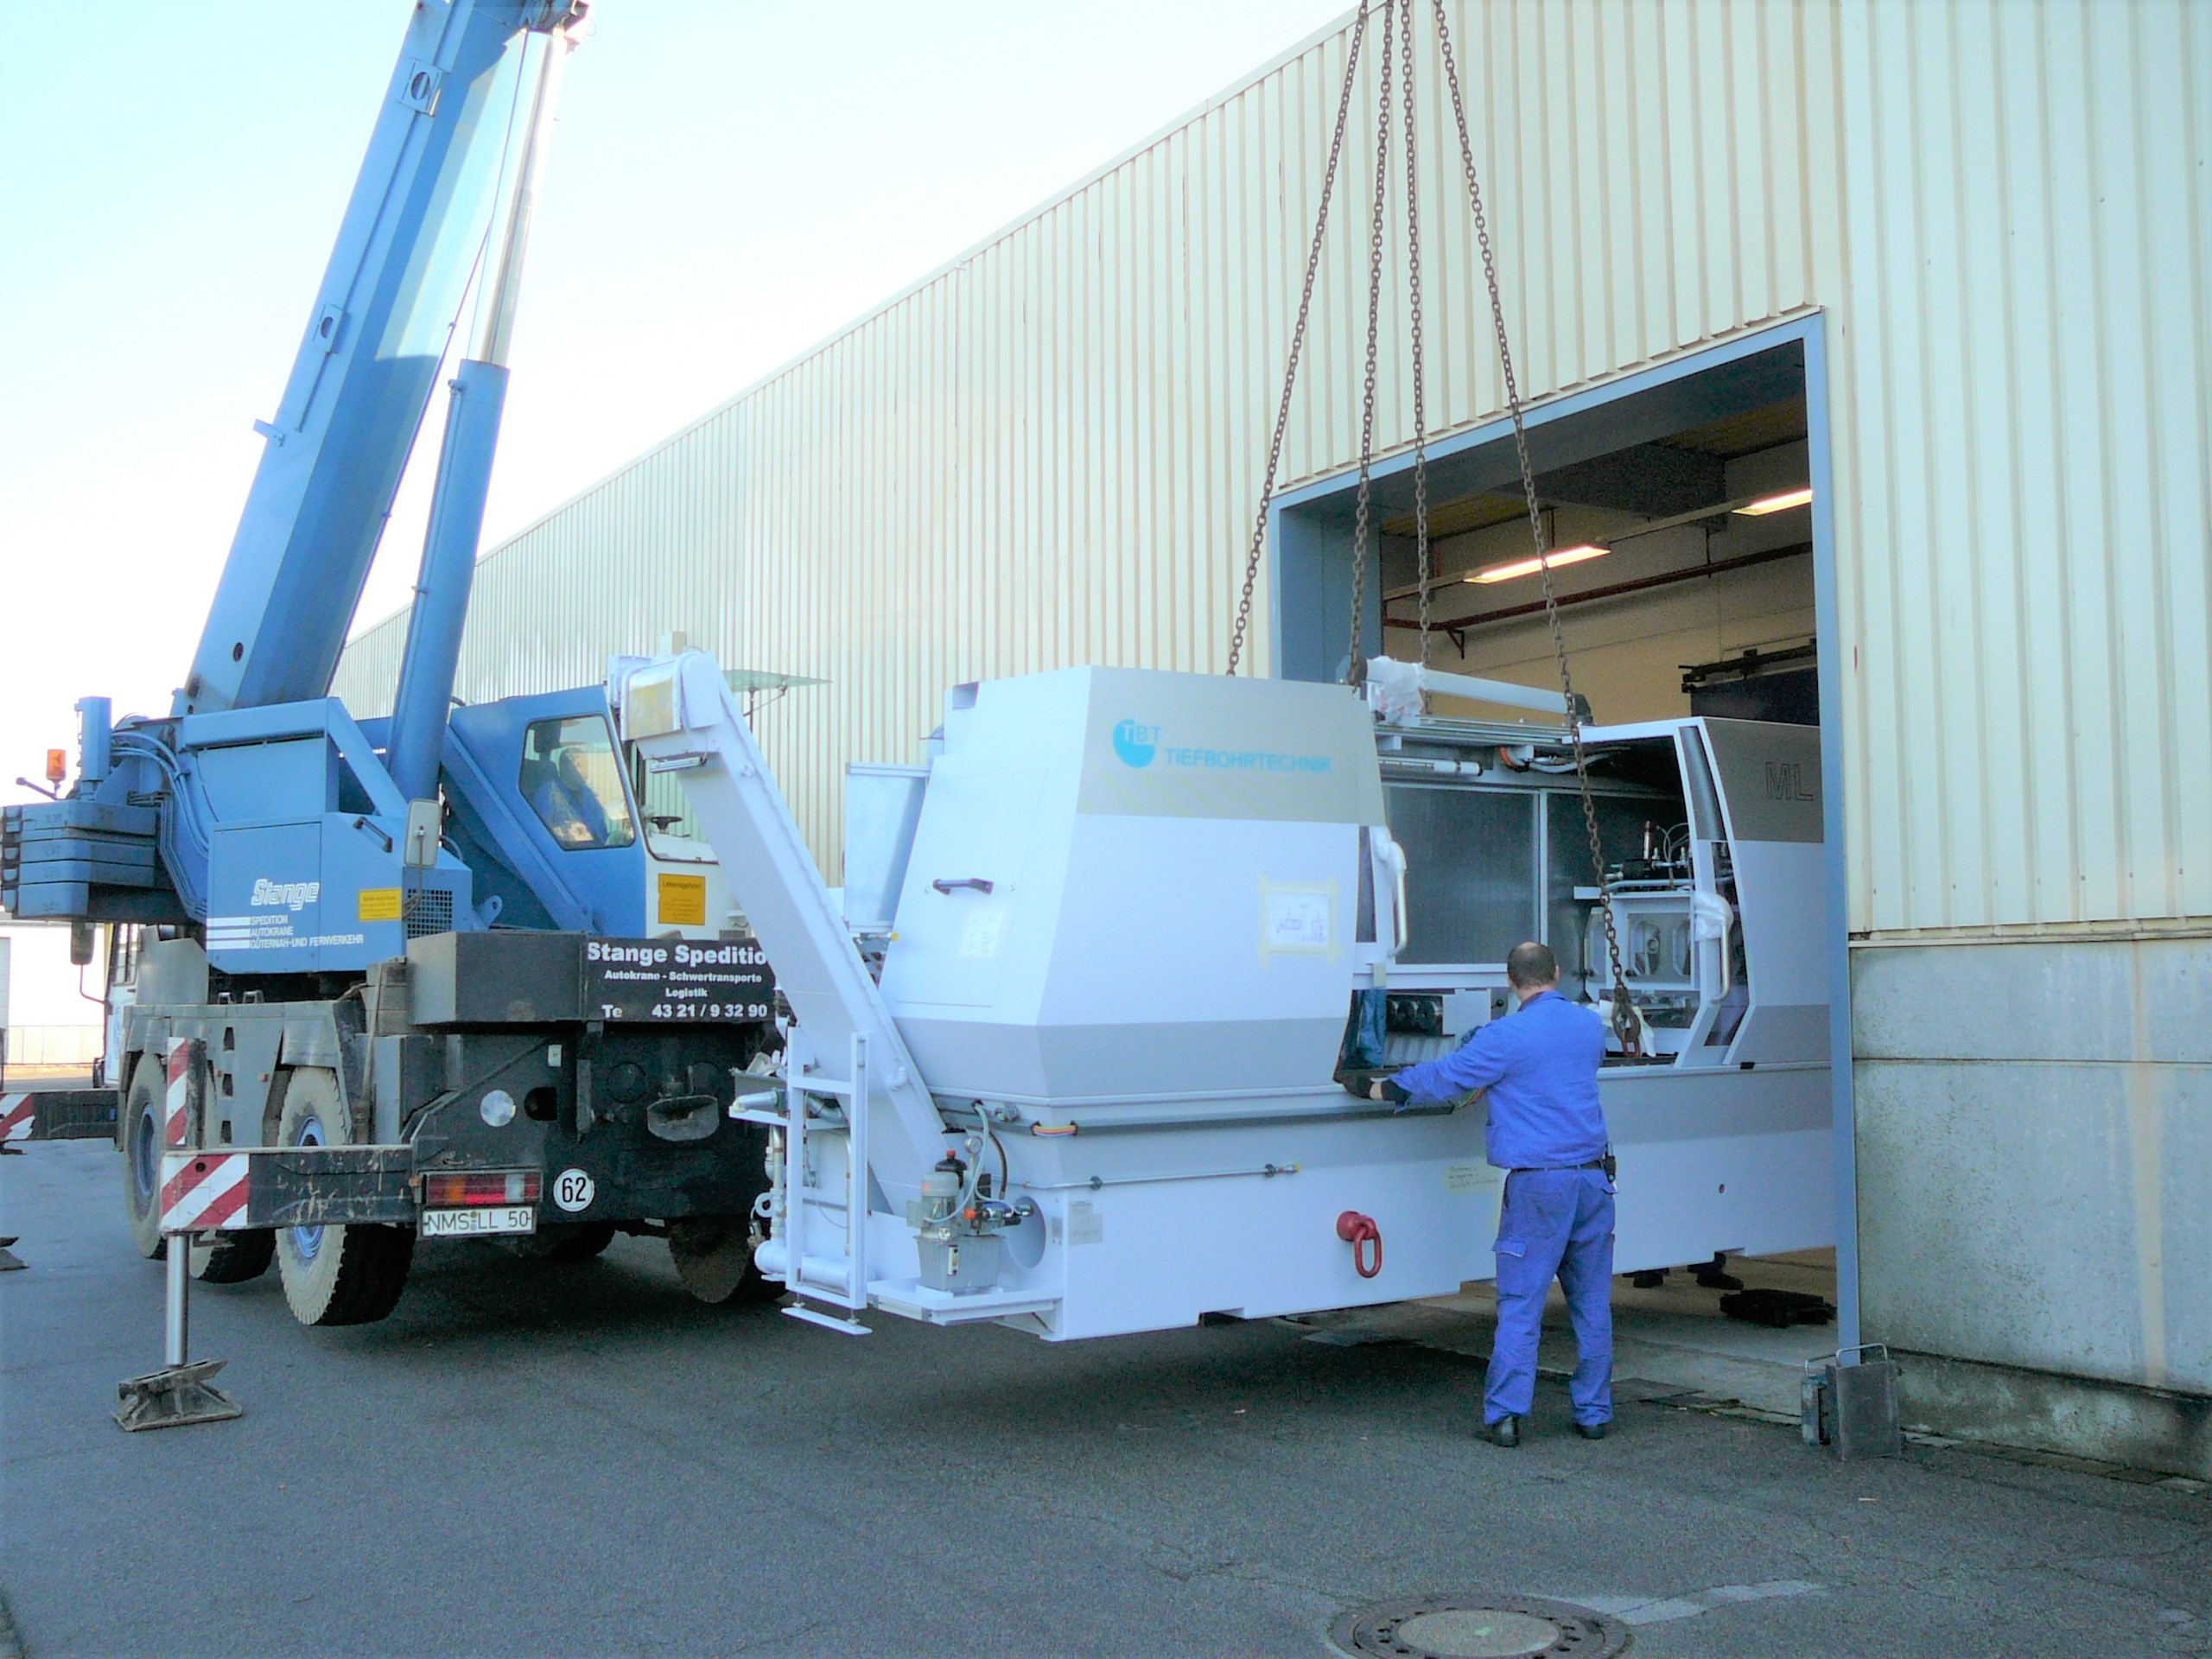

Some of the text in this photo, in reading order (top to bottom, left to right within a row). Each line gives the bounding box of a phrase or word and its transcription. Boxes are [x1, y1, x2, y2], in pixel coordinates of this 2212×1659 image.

[1165, 747, 1334, 772] TIEFBOHRTECHNIK
[1765, 761, 1814, 801] ML
[251, 879, 320, 911] Stange
[251, 915, 289, 925] SPEDITION
[251, 926, 294, 938] AUTOKRANE
[309, 934, 364, 946] FERNVERKEHR
[587, 942, 766, 967] Stange Speditio
[604, 969, 660, 981] Autokrane
[669, 971, 762, 984] Schwertransporte
[664, 988, 708, 999] Logistik
[652, 1004, 672, 1018] 43
[677, 1004, 695, 1018] 21
[710, 1004, 720, 1018] 9
[725, 1004, 743, 1018] 32
[748, 1004, 767, 1018] 90
[562, 1177, 586, 1202] 62
[508, 1211, 529, 1228] 50
